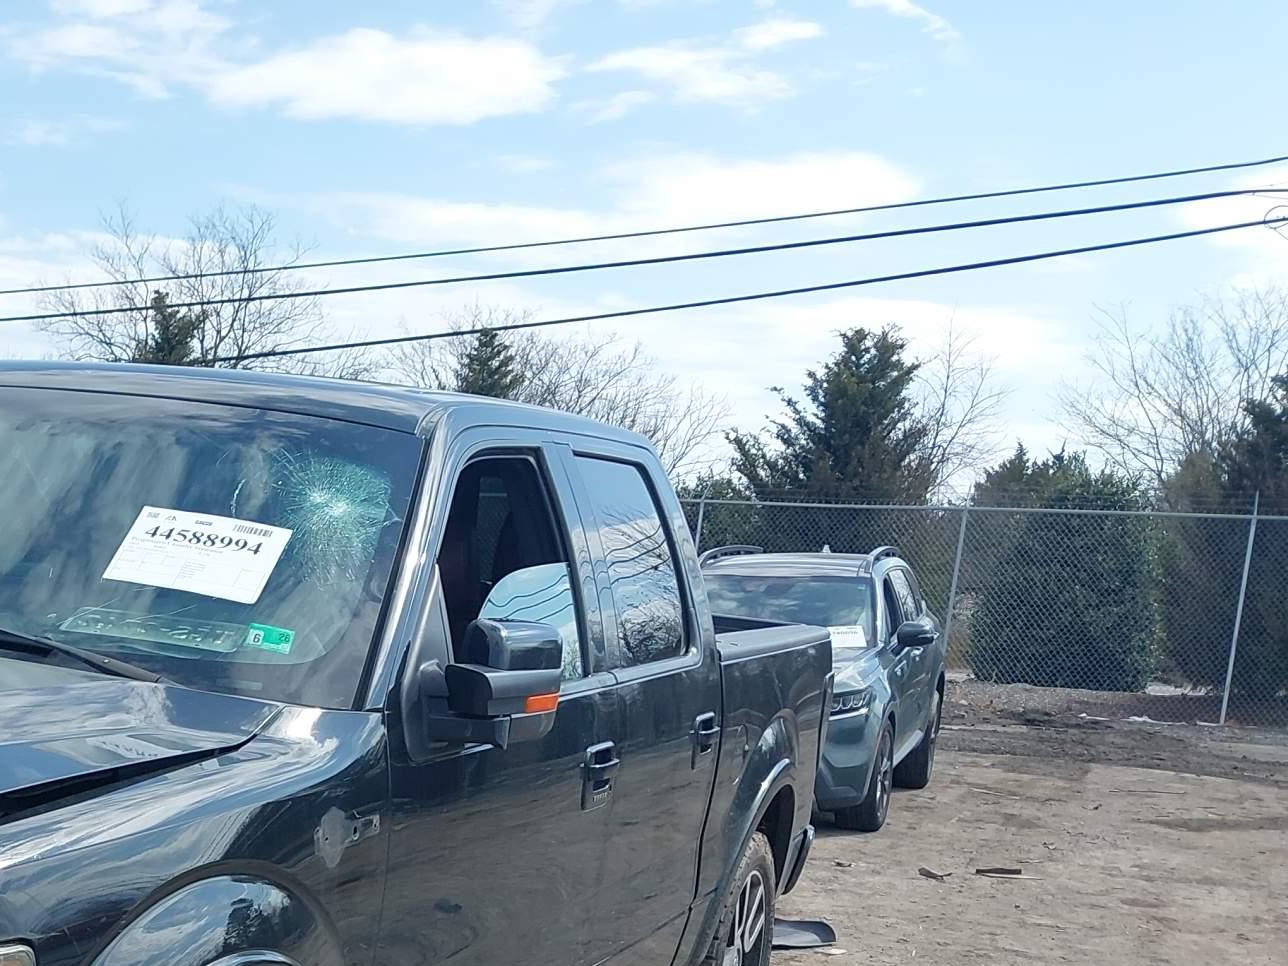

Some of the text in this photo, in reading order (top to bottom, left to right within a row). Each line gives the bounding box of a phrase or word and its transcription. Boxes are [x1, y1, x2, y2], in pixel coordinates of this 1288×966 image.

[145, 525, 263, 555] 44588994
[252, 632, 291, 644] 6 26
